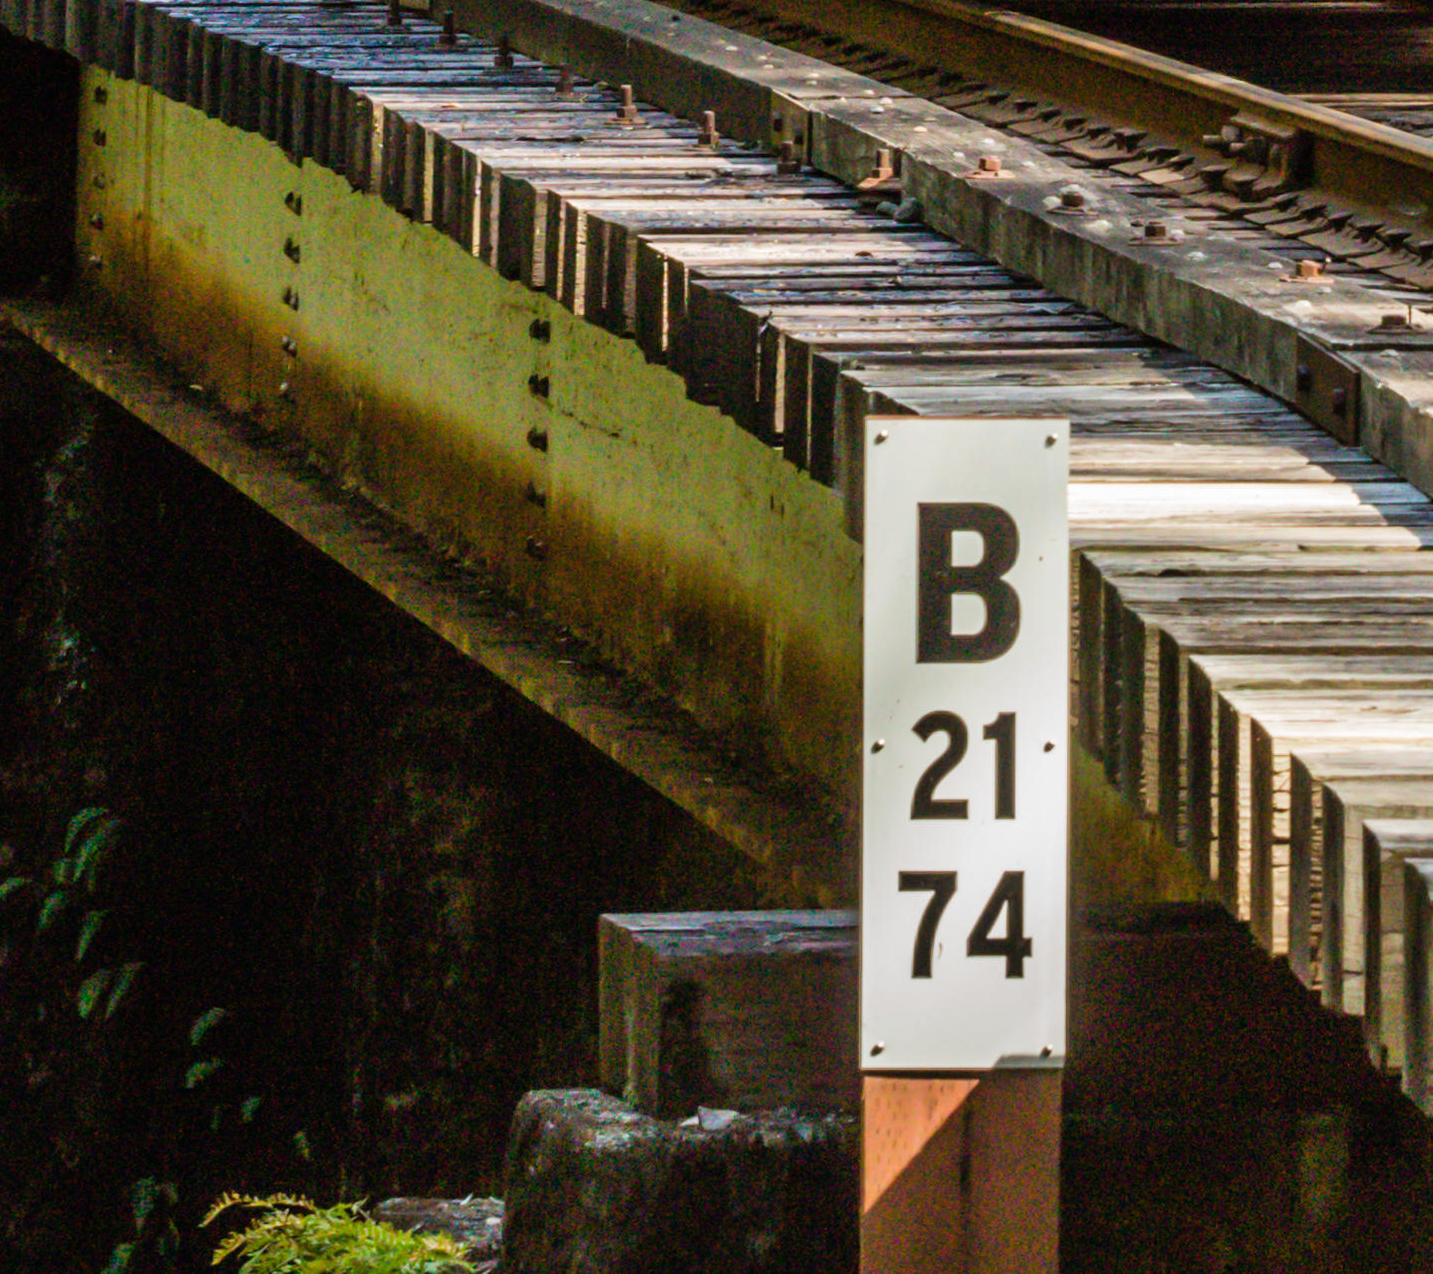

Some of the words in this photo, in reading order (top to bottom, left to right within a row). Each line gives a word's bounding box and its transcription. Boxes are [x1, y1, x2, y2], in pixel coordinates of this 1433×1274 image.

[916, 502, 1021, 664] B
[910, 710, 1016, 820] 21
[898, 870, 1033, 979] 74
